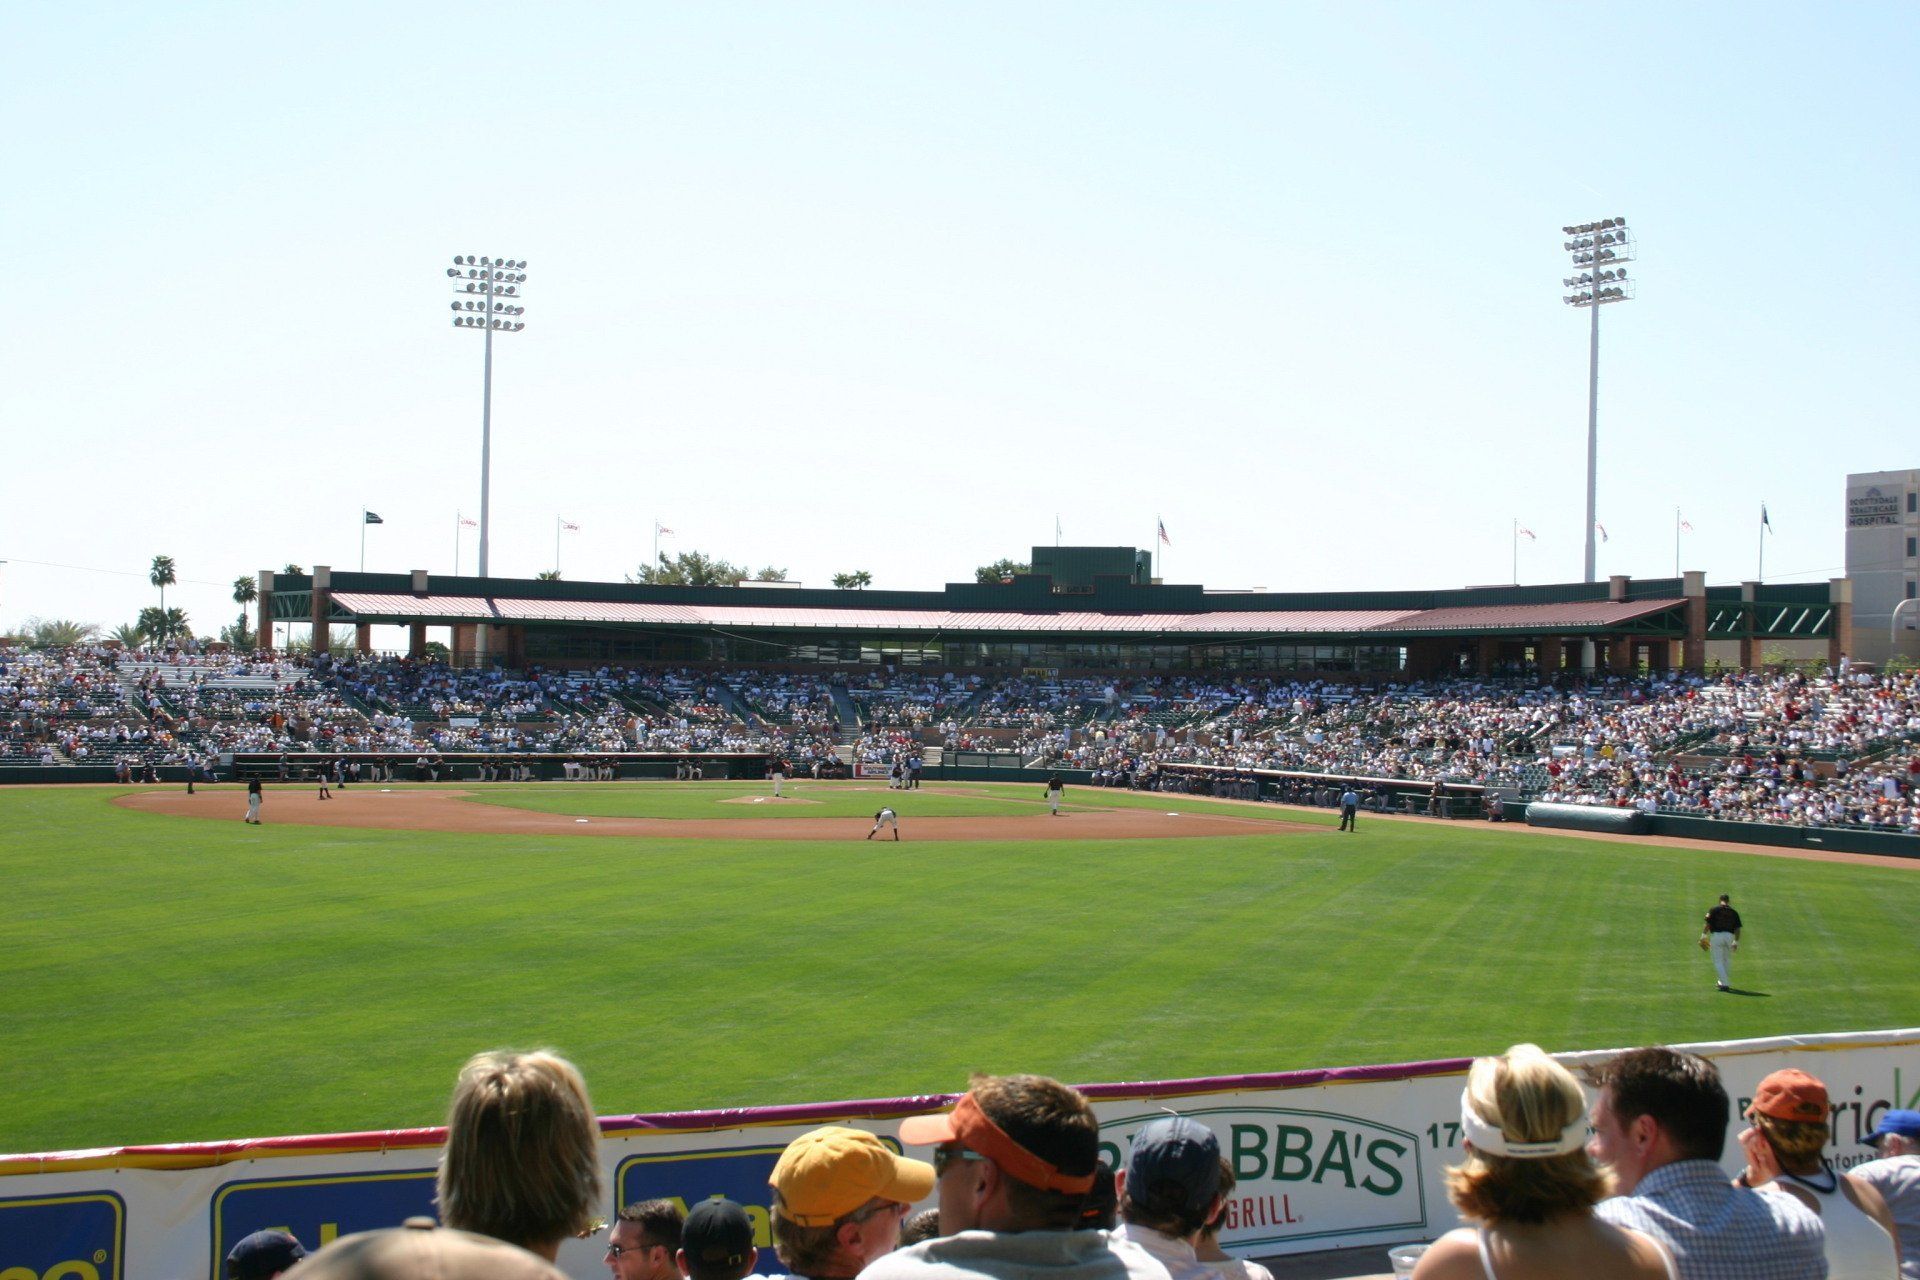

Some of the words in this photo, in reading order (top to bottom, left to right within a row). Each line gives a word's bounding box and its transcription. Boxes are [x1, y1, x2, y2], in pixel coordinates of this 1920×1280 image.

[1848, 516, 1898, 526] HOSPITAL
[1830, 1085, 1891, 1146] ric
[1427, 1122, 1465, 1148] 17
[1226, 1194, 1297, 1229] GRILL
